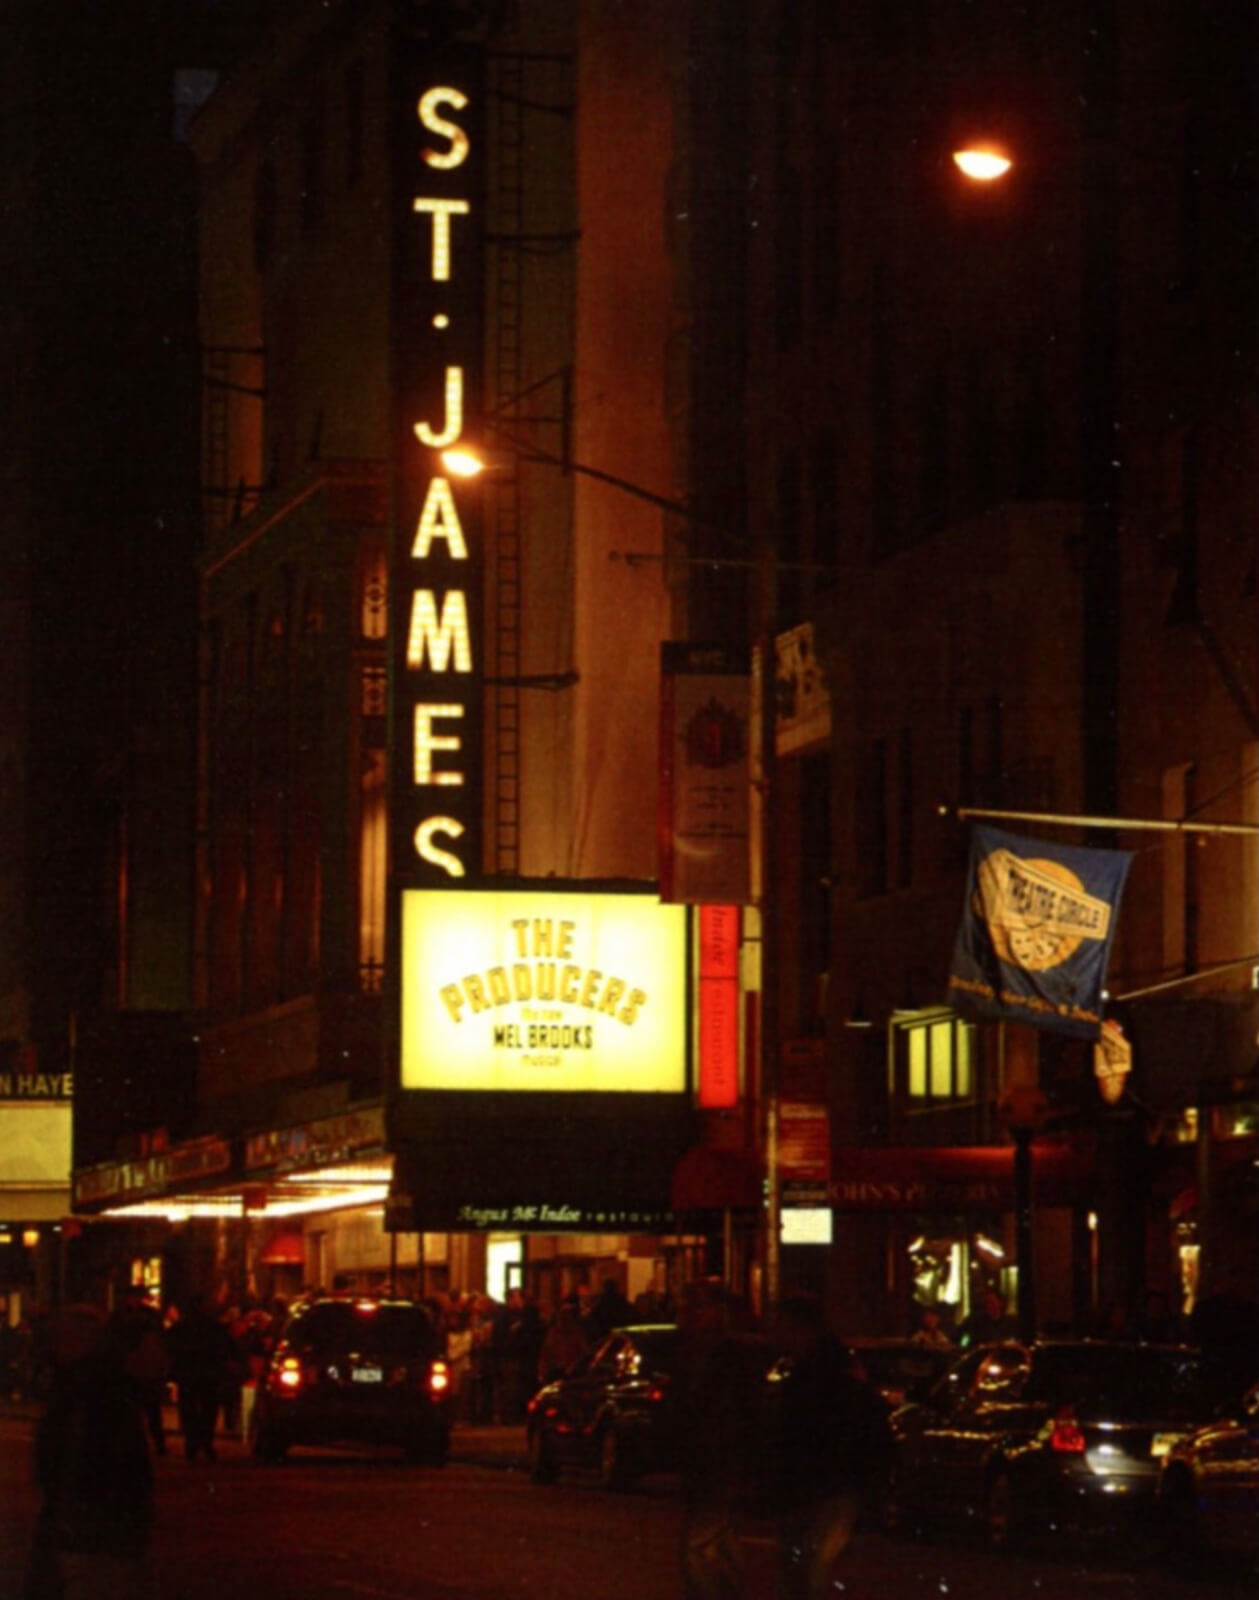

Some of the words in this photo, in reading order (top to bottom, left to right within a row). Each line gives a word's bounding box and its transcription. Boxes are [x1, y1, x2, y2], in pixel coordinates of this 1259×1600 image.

[1057, 894, 1099, 930] CIRCLE
[512, 919, 575, 959] THE
[439, 963, 647, 1026] PRODUCERS
[494, 1025, 523, 1049] MEL
[528, 1025, 592, 1049] BROOKS
[458, 1205, 509, 1226] Angus
